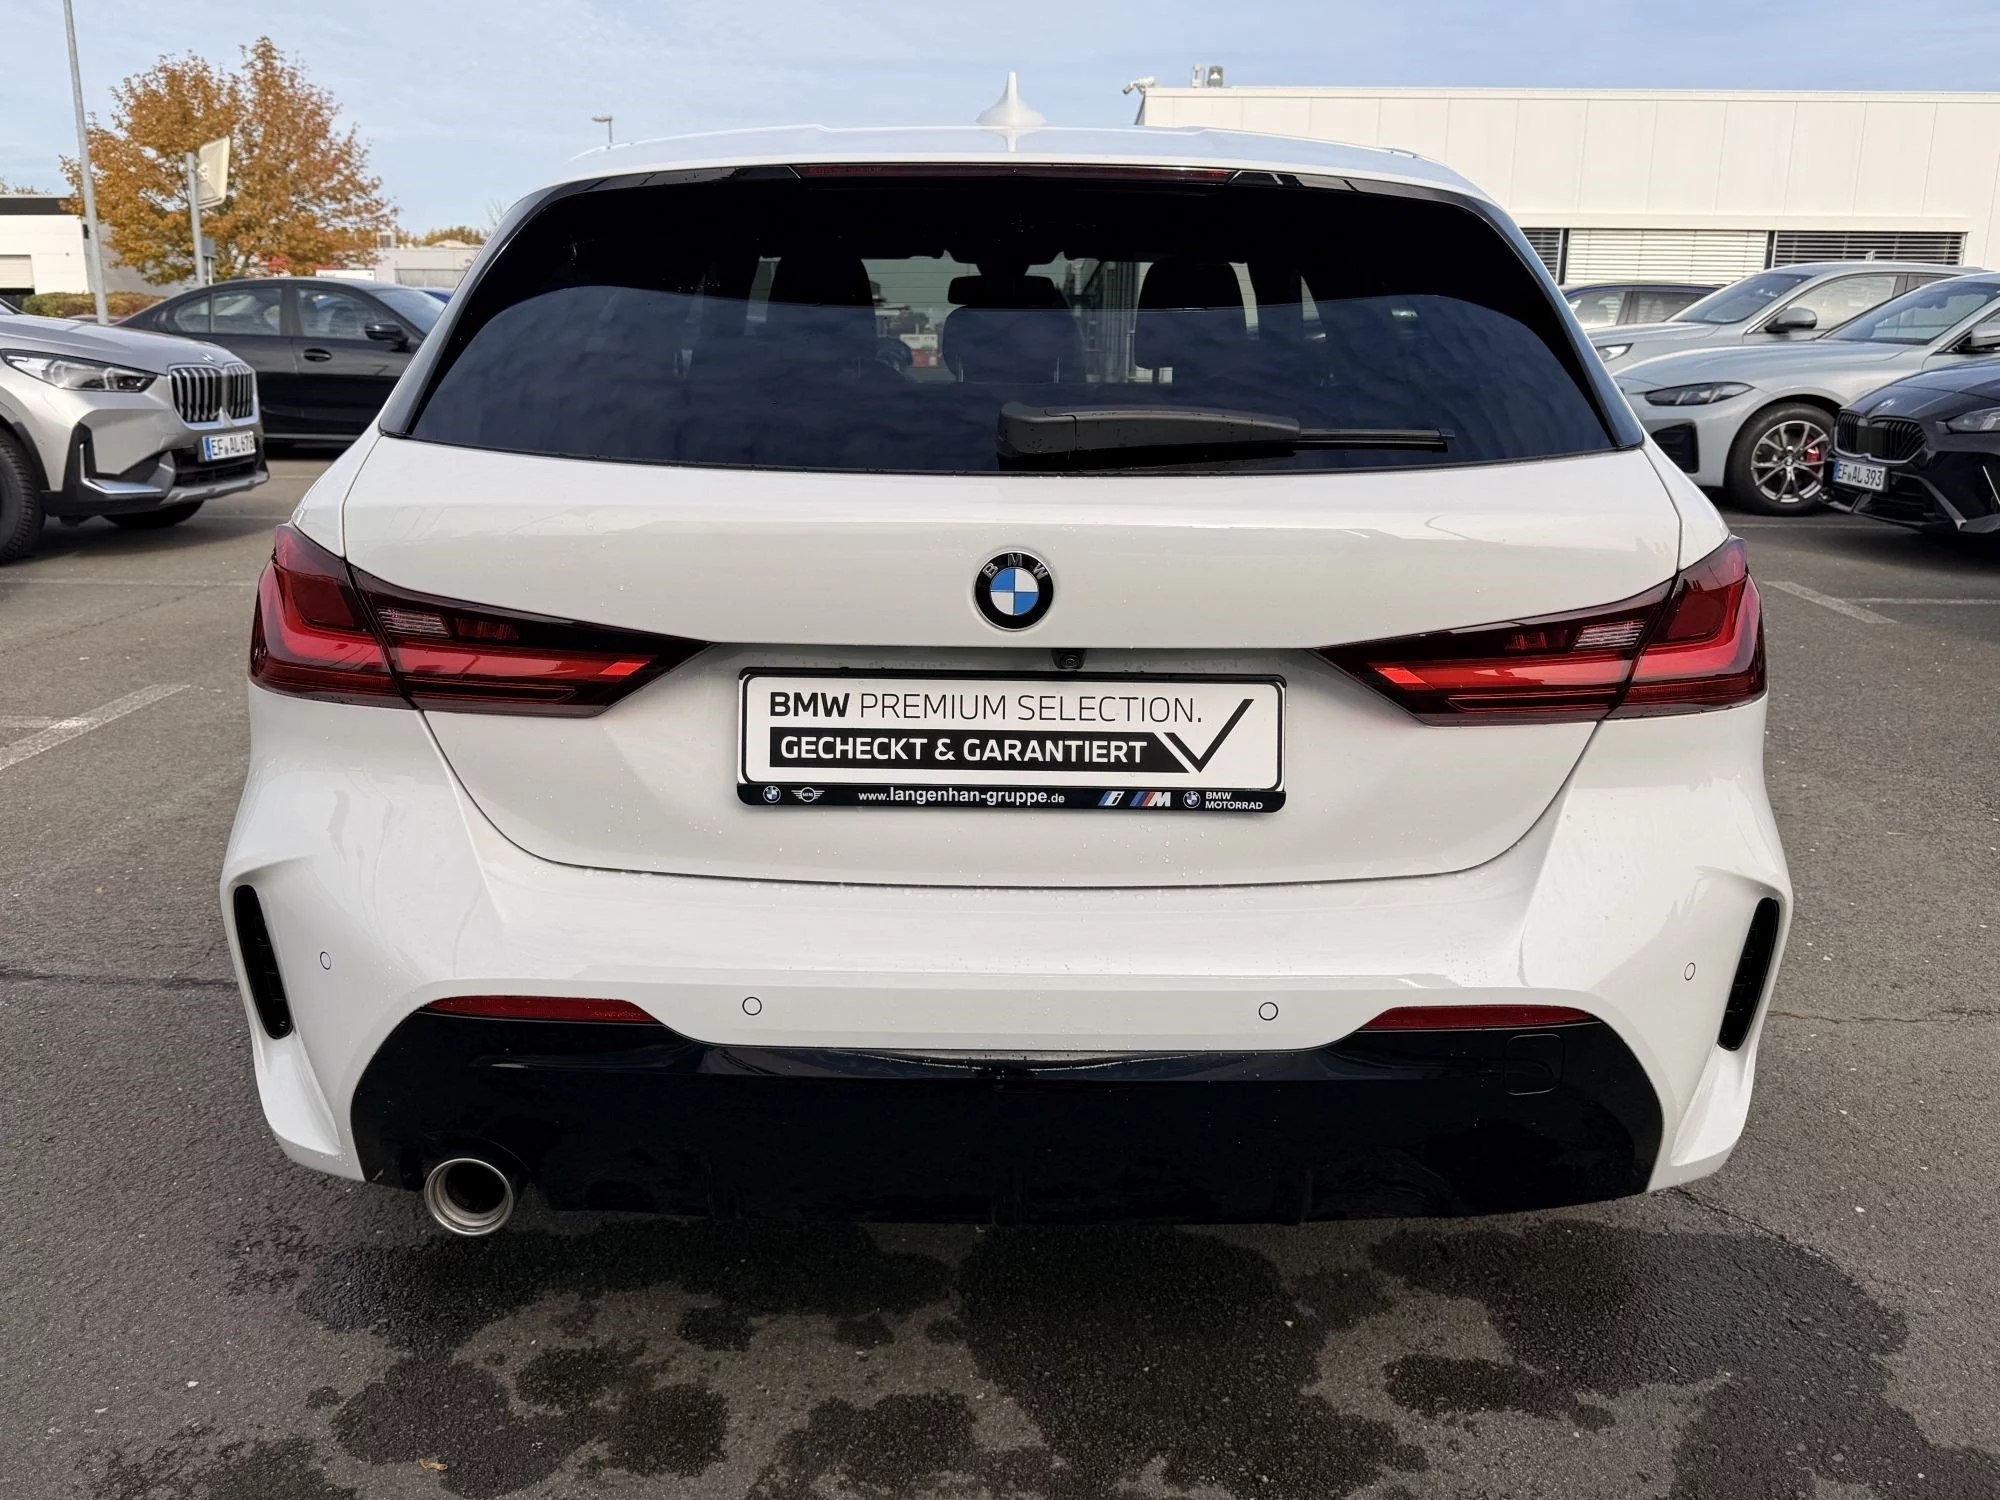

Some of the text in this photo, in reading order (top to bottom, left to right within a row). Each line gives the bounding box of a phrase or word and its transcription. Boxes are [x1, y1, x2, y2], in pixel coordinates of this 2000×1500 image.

[1837, 463, 1883, 487] EF AL 393
[982, 553, 1048, 580] BMW
[769, 691, 1202, 723] BMW PREMIUM SELECTION.
[780, 736, 1148, 763] GECHECKT & GARANTIERT
[858, 786, 1065, 807] www.langenhan-gruppe.de
[1205, 791, 1232, 800] BMW
[1205, 800, 1263, 810] MOTORRAD
